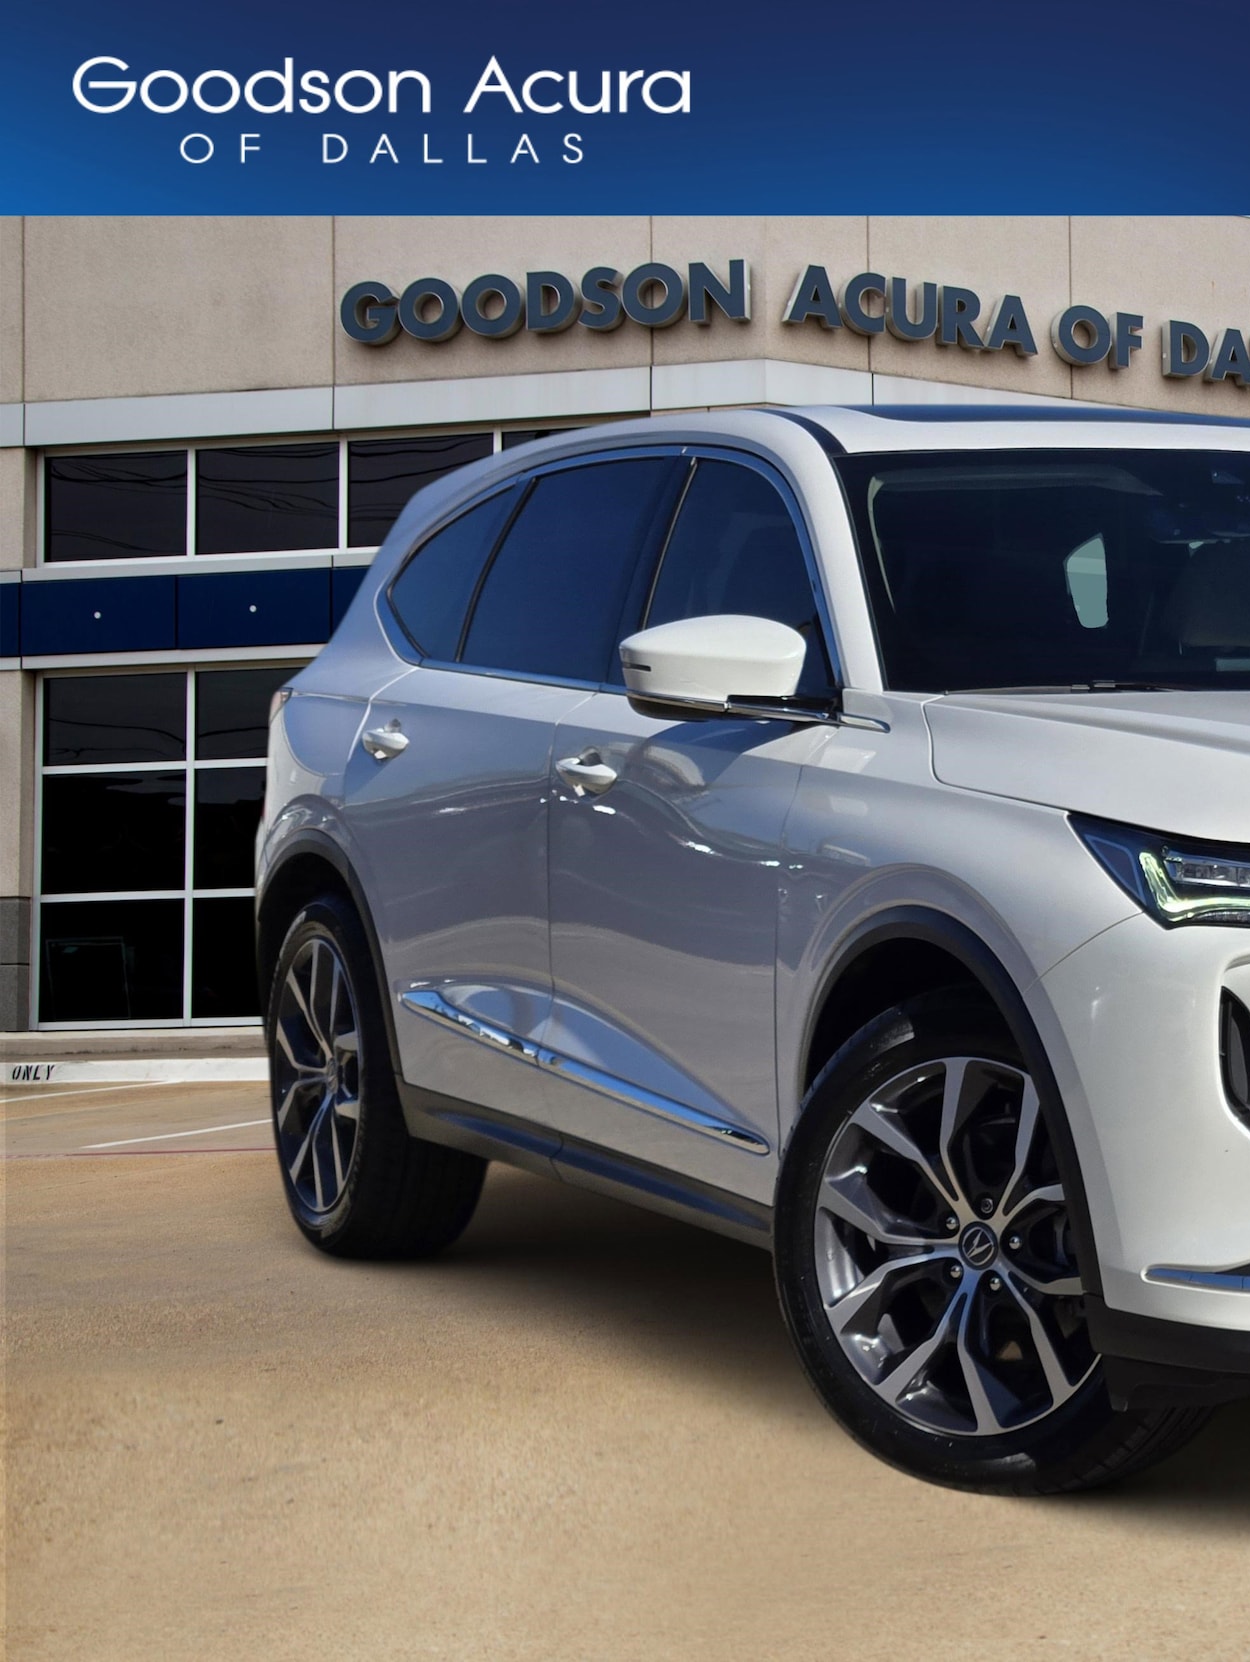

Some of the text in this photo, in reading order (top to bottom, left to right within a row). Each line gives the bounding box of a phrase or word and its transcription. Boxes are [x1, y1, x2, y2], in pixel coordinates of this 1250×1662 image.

[339, 259, 751, 347] GOODSON
[782, 264, 1038, 357] ACURA
[1052, 305, 1144, 370] OF
[11, 1064, 55, 1081] ONLY
